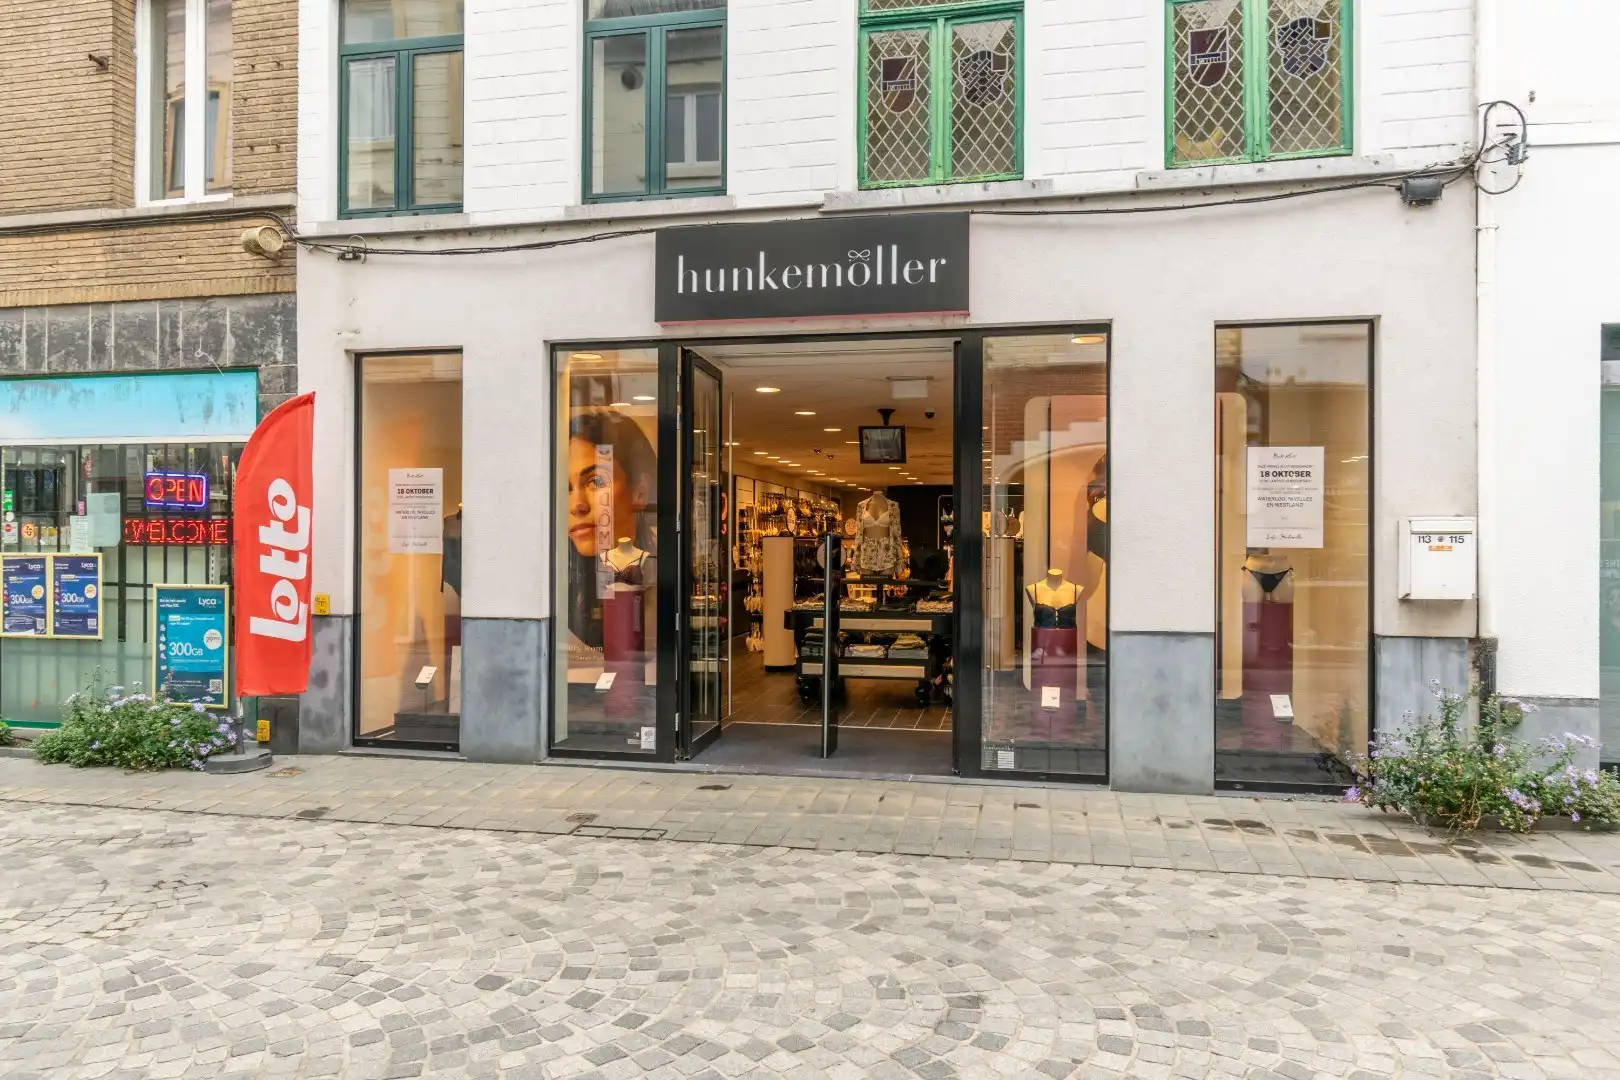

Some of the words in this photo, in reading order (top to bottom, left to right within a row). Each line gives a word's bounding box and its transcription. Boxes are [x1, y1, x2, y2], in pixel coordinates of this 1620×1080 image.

[1260, 470, 1270, 478] 18
[1271, 470, 1311, 478] OKTOBER
[149, 477, 202, 502] OPEN
[132, 522, 228, 541] WELCOME
[1418, 535, 1432, 544] 113
[1449, 535, 1465, 544] 115
[249, 478, 311, 642] Lotto
[28, 563, 41, 571] Lyca
[198, 597, 217, 607] Lyca
[169, 641, 204, 656] 300GB
